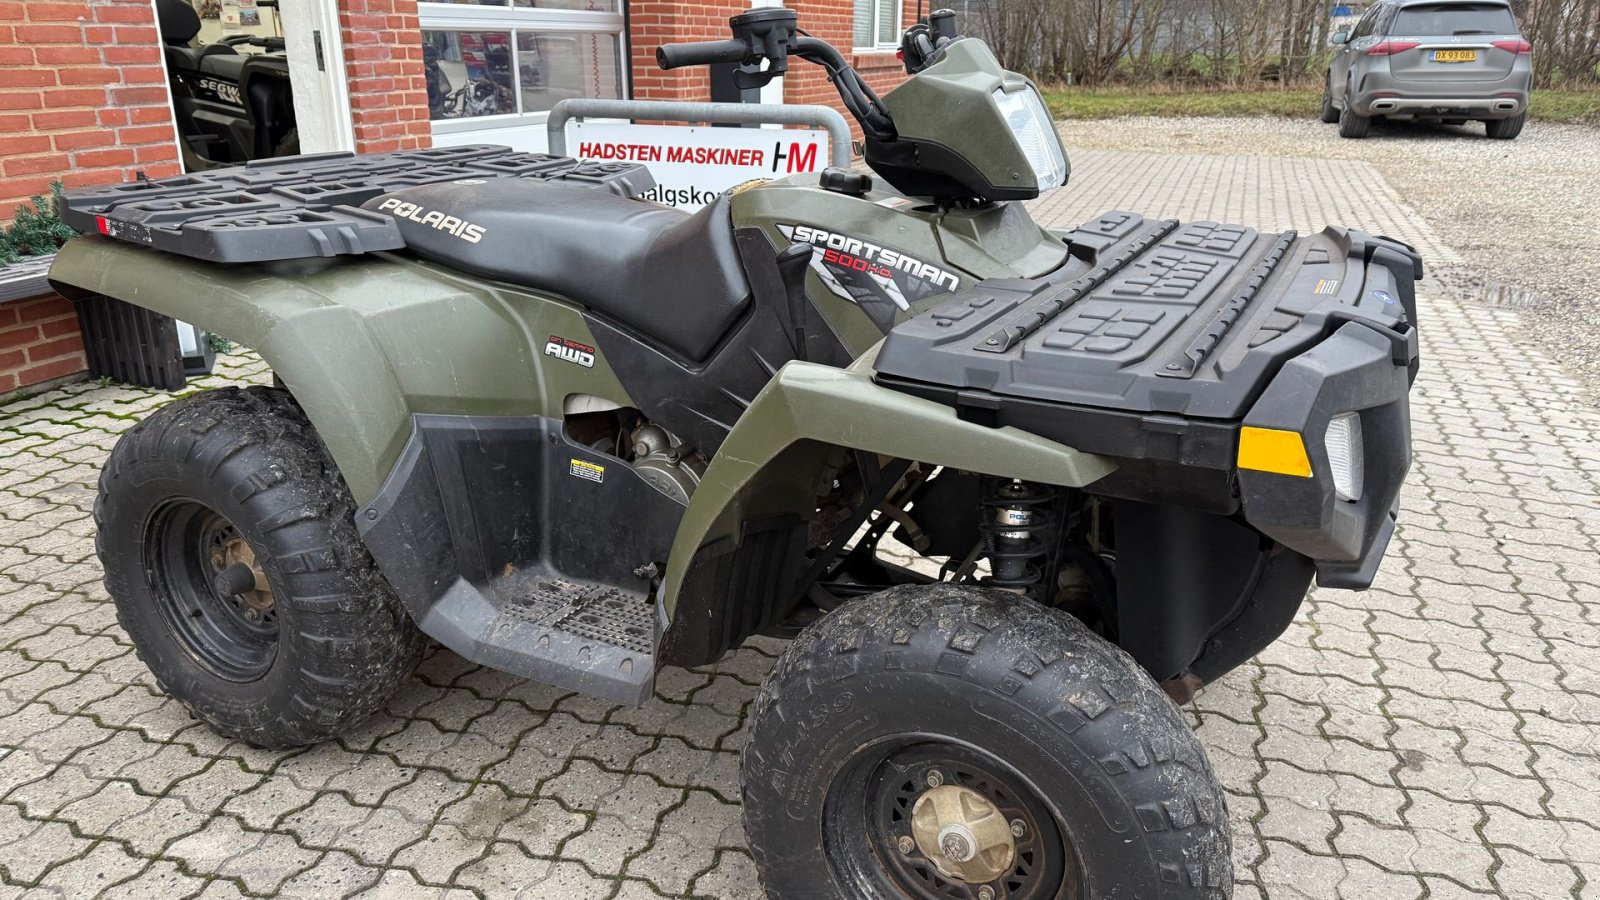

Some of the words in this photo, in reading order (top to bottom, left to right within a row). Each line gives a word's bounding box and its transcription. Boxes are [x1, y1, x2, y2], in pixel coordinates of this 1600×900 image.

[1435, 51, 1447, 59] DX
[1448, 51, 1459, 59] 93
[1460, 51, 1475, 59] 083
[579, 142, 663, 162] HADSTEN
[666, 146, 764, 167] MASKINER
[378, 198, 487, 244] POLARIS
[792, 225, 960, 291] SPORTSMAN
[823, 249, 868, 272] 500
[545, 342, 595, 368] AWD
